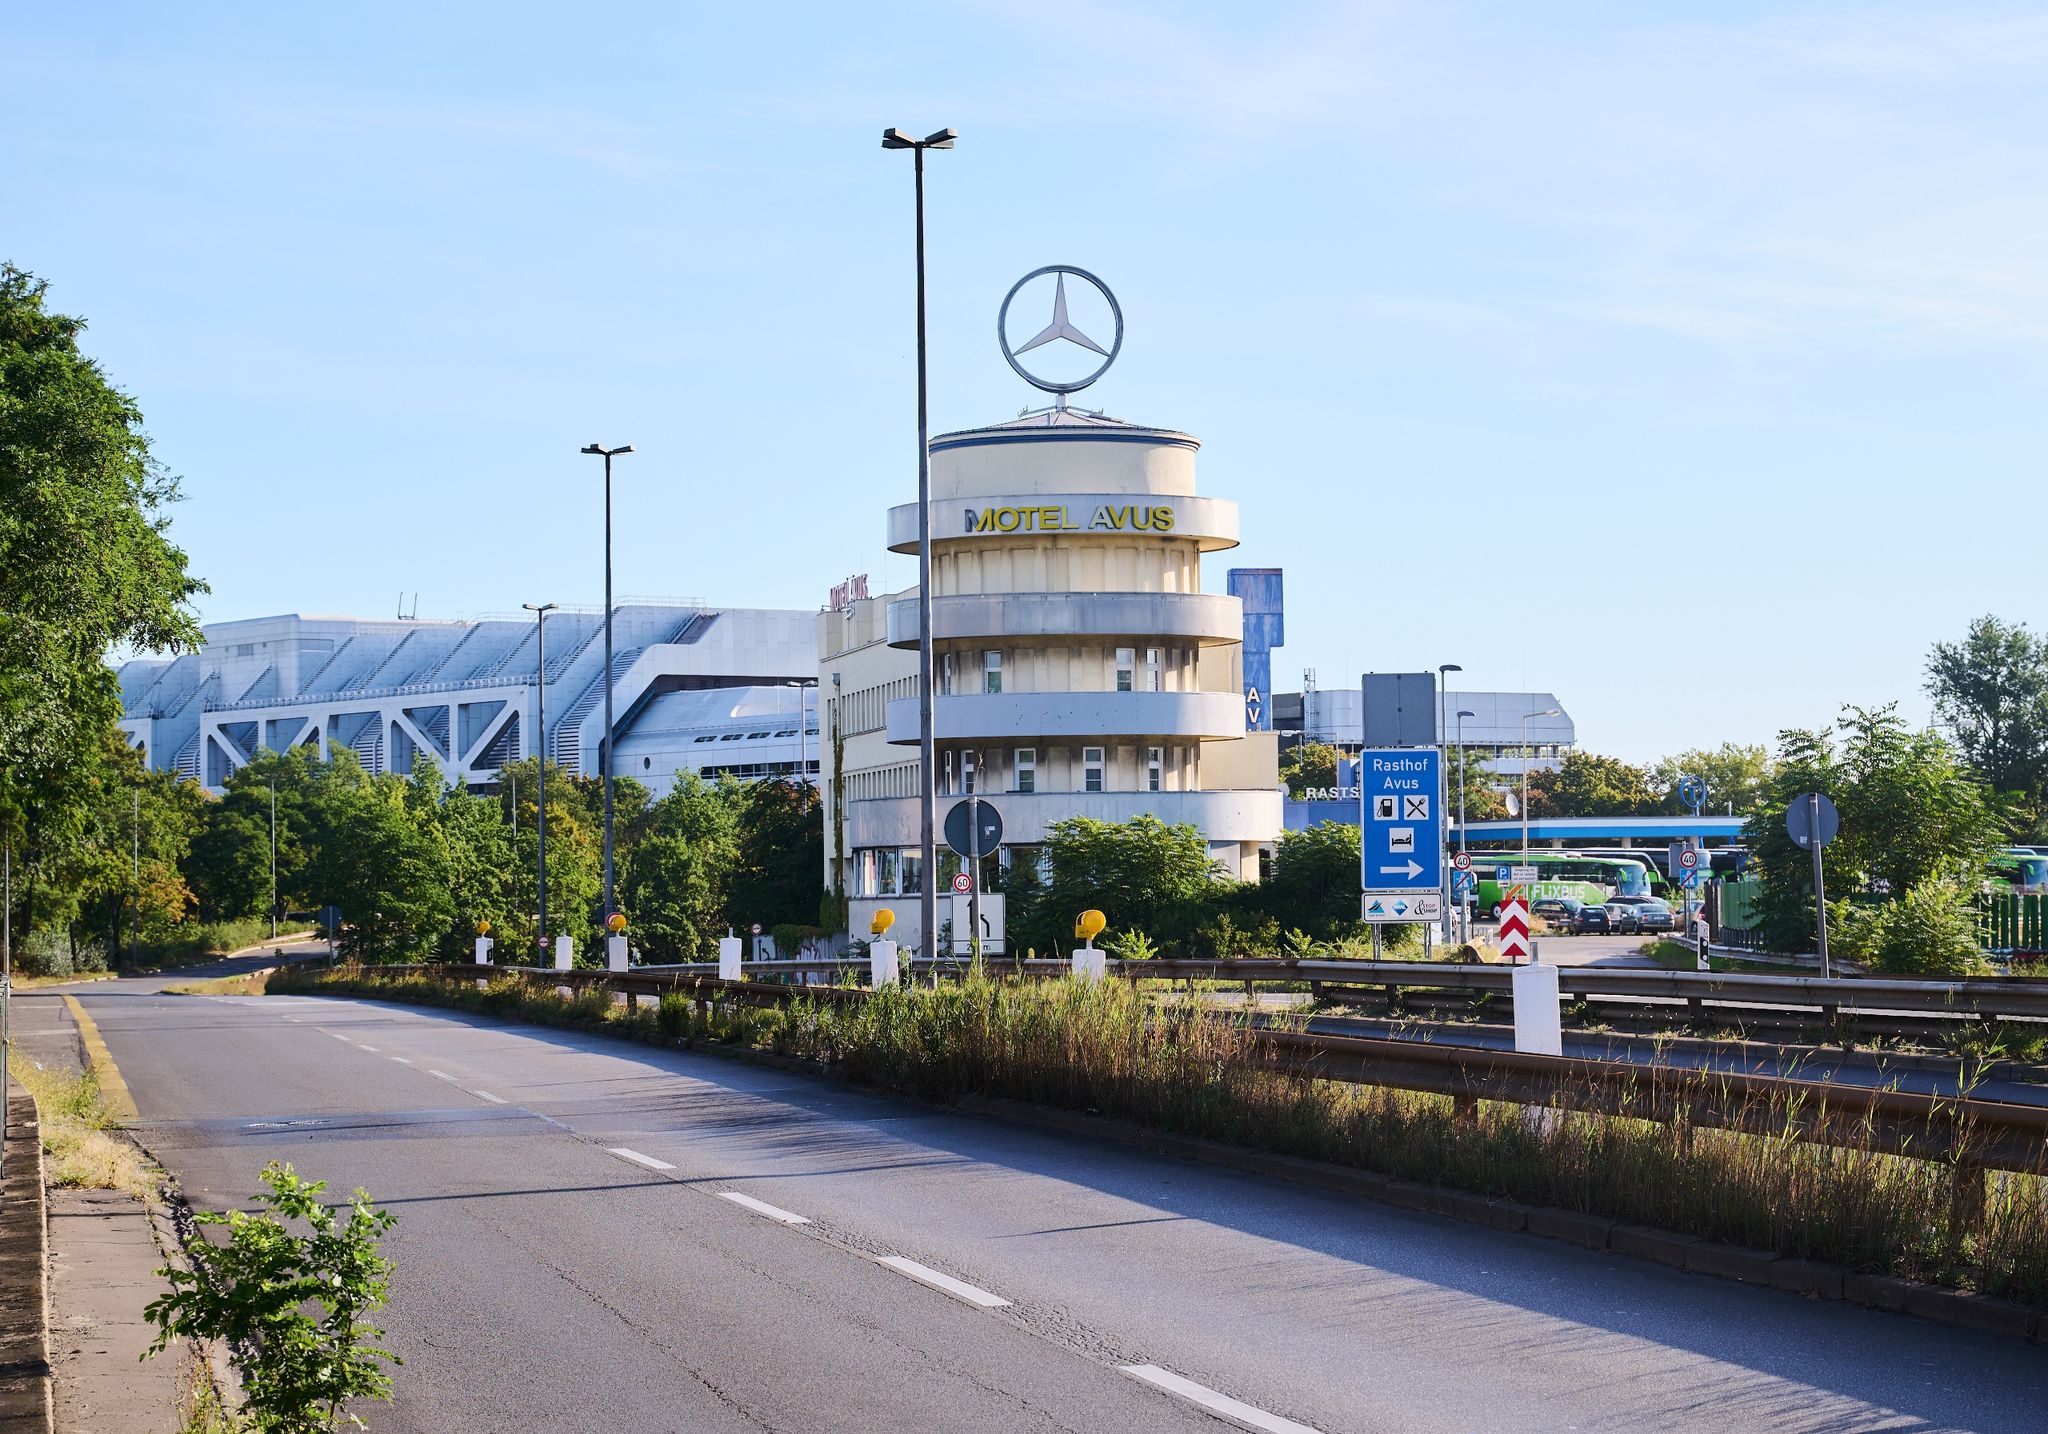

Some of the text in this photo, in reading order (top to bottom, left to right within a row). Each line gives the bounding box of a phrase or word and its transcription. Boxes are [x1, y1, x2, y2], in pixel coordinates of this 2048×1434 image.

[965, 505, 1175, 532] MOTEL AVUS
[1373, 758, 1428, 772] Rasthof
[1383, 776, 1419, 790] Avus
[1457, 857, 1468, 866] 40
[1683, 855, 1694, 864] 40
[1499, 868, 1507, 878] P
[958, 879, 968, 888] 60
